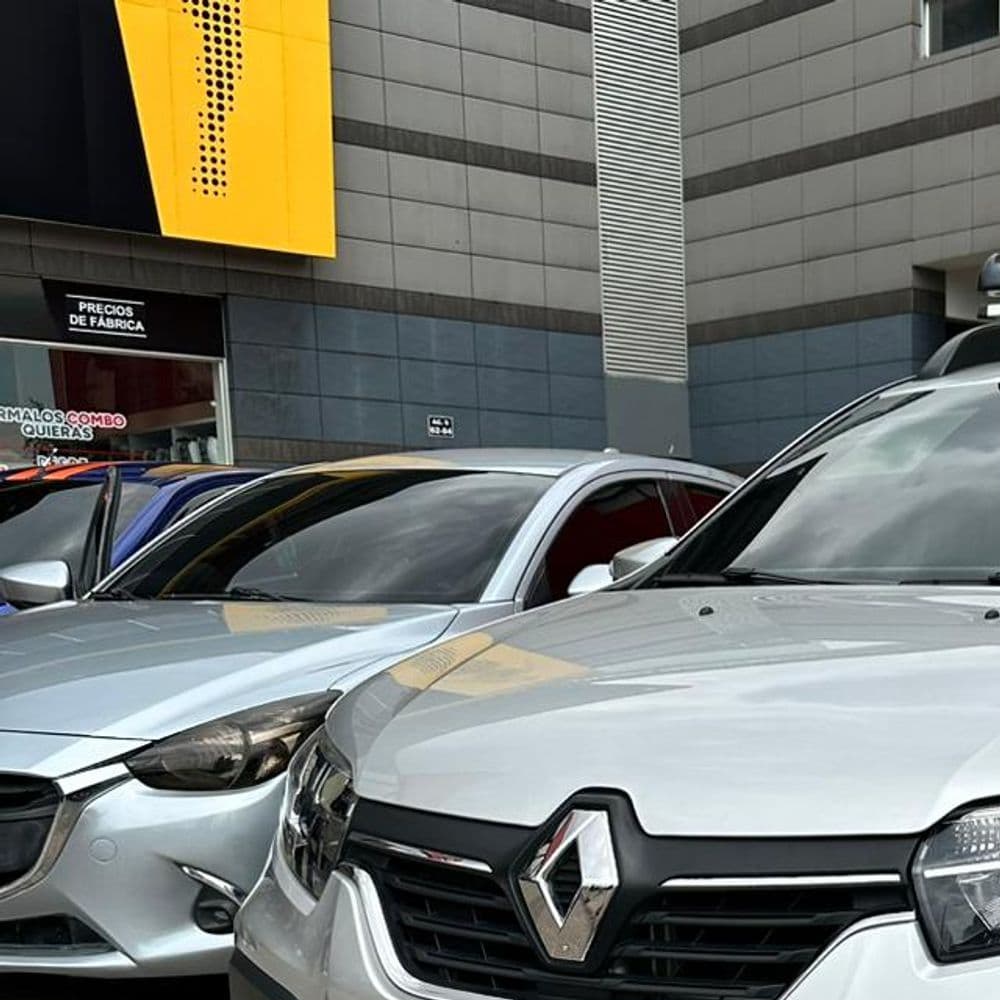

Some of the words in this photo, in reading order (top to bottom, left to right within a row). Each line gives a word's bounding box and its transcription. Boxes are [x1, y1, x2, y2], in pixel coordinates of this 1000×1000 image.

[78, 301, 134, 317] PRECIOS
[69, 314, 87, 326] DE
[66, 410, 127, 429] COMBO
[21, 422, 94, 440] QUIERAS
